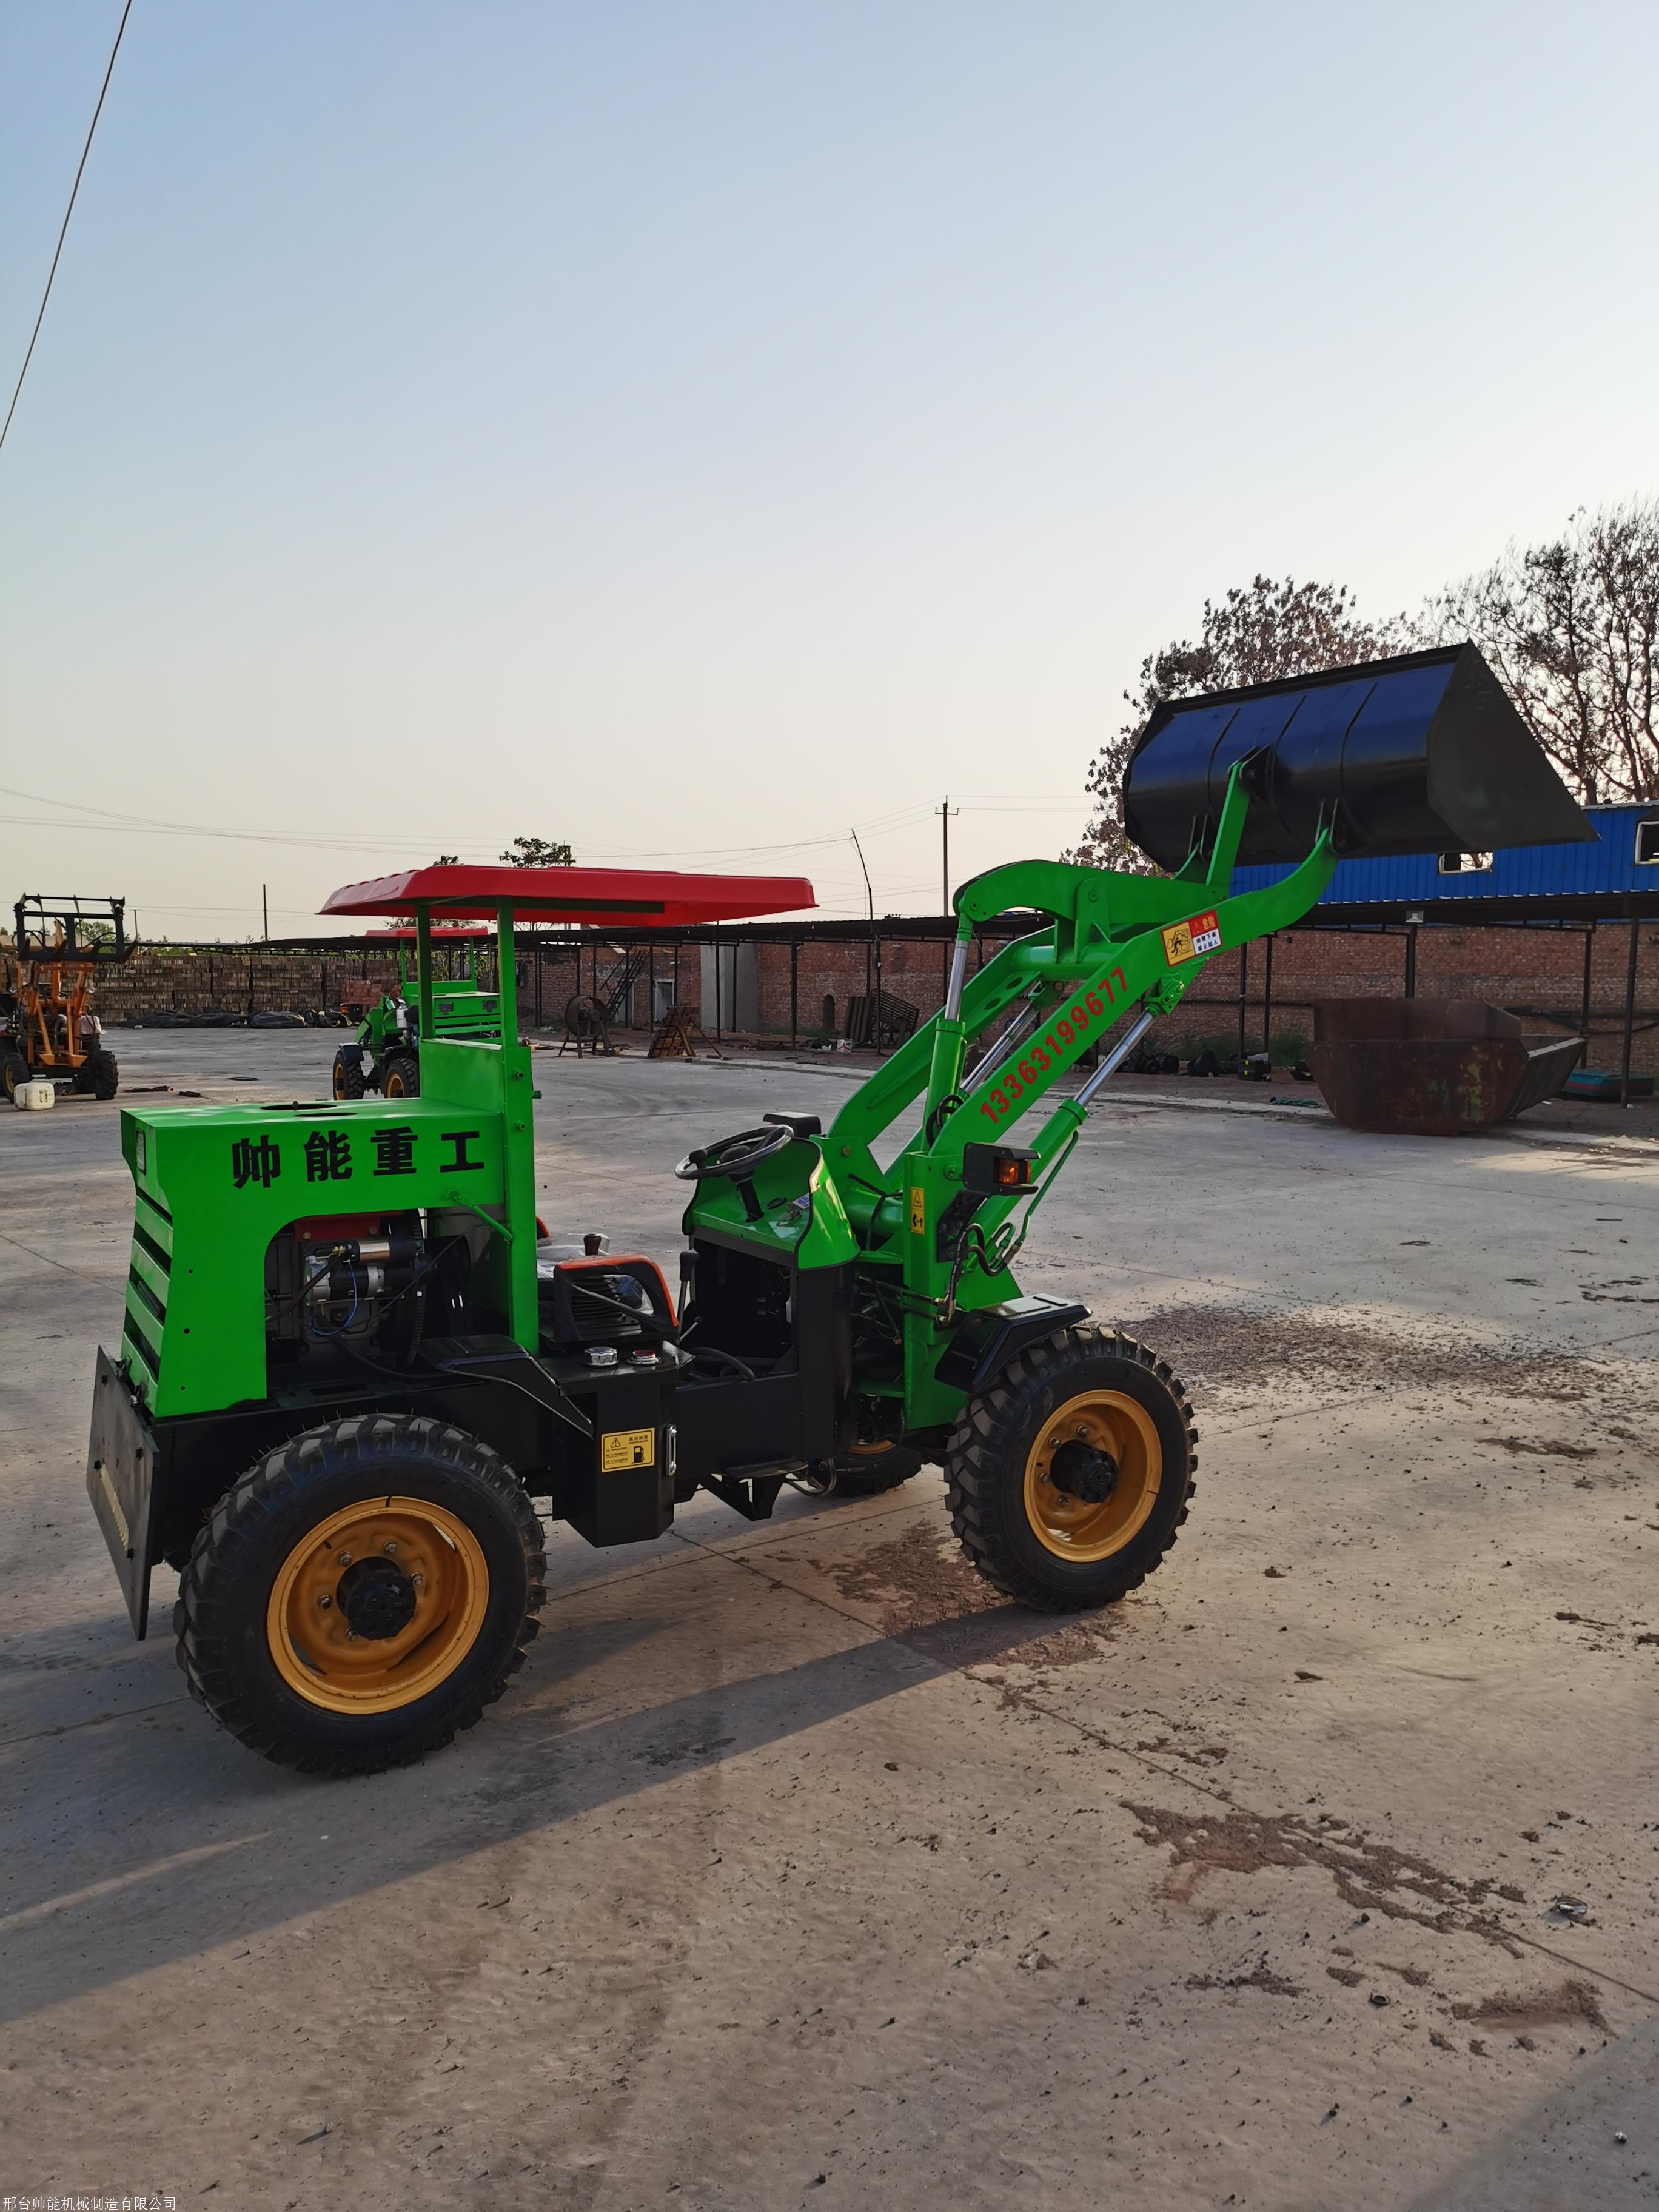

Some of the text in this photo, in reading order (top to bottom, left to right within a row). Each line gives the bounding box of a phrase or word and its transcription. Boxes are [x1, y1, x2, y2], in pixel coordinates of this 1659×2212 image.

[980, 967, 1127, 1124] 13363199677
[232, 1126, 484, 1189] 帅能重工
